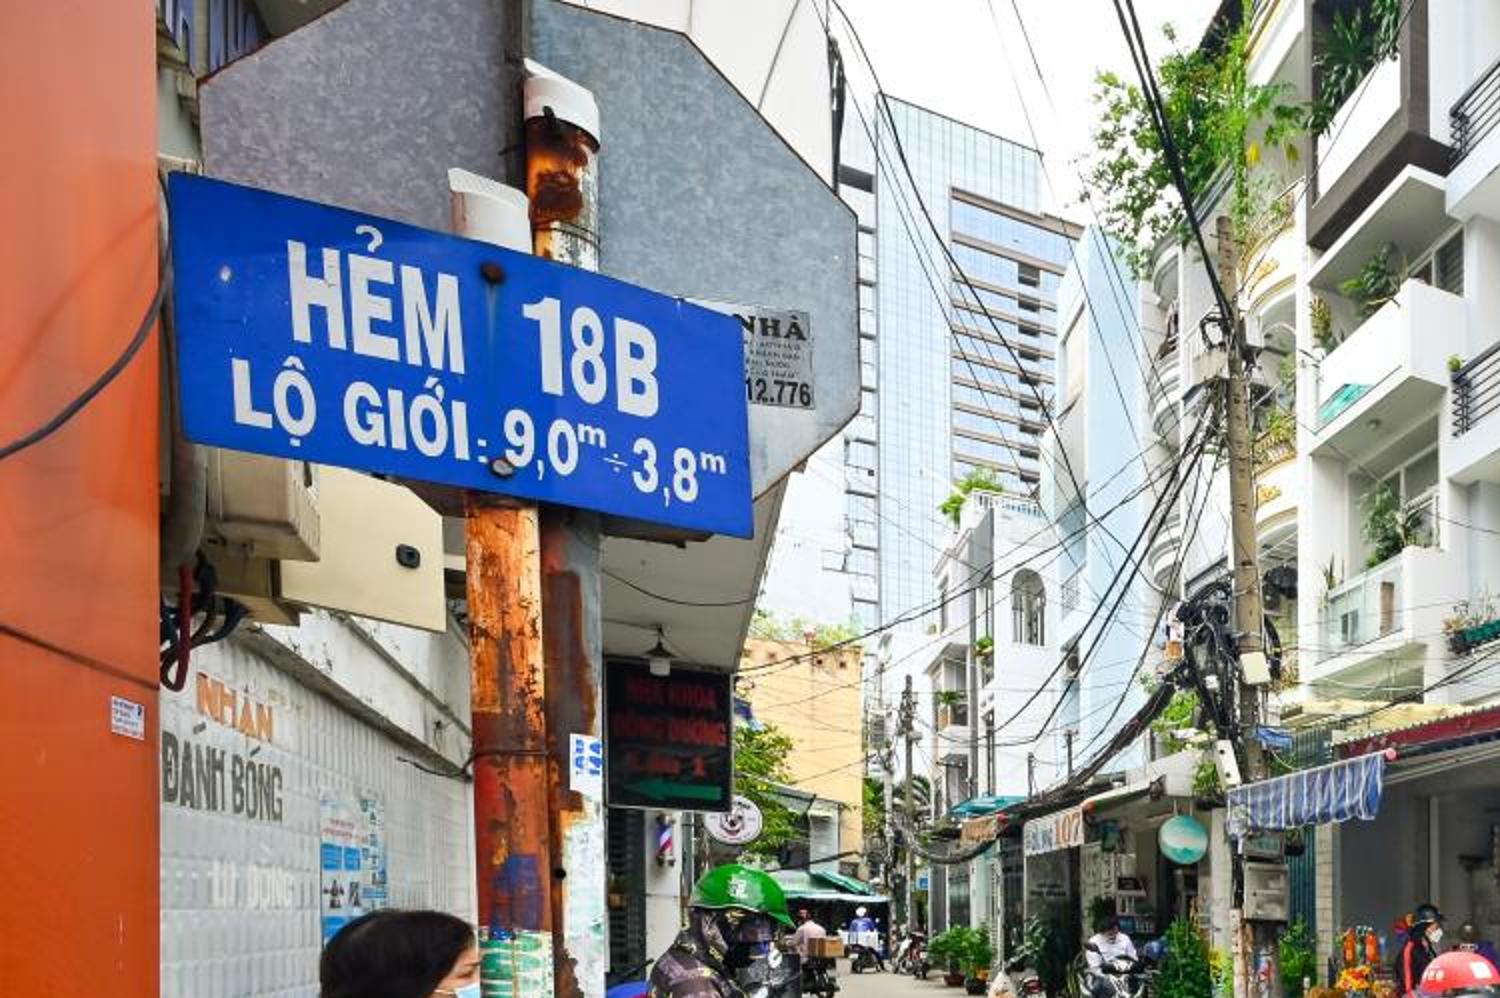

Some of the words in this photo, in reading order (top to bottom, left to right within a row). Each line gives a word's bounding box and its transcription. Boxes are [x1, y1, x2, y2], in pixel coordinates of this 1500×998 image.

[287, 225, 465, 375] HẺM
[522, 297, 659, 418] 18B
[232, 355, 317, 447] LỘ
[231, 746, 283, 824] BÓNG
